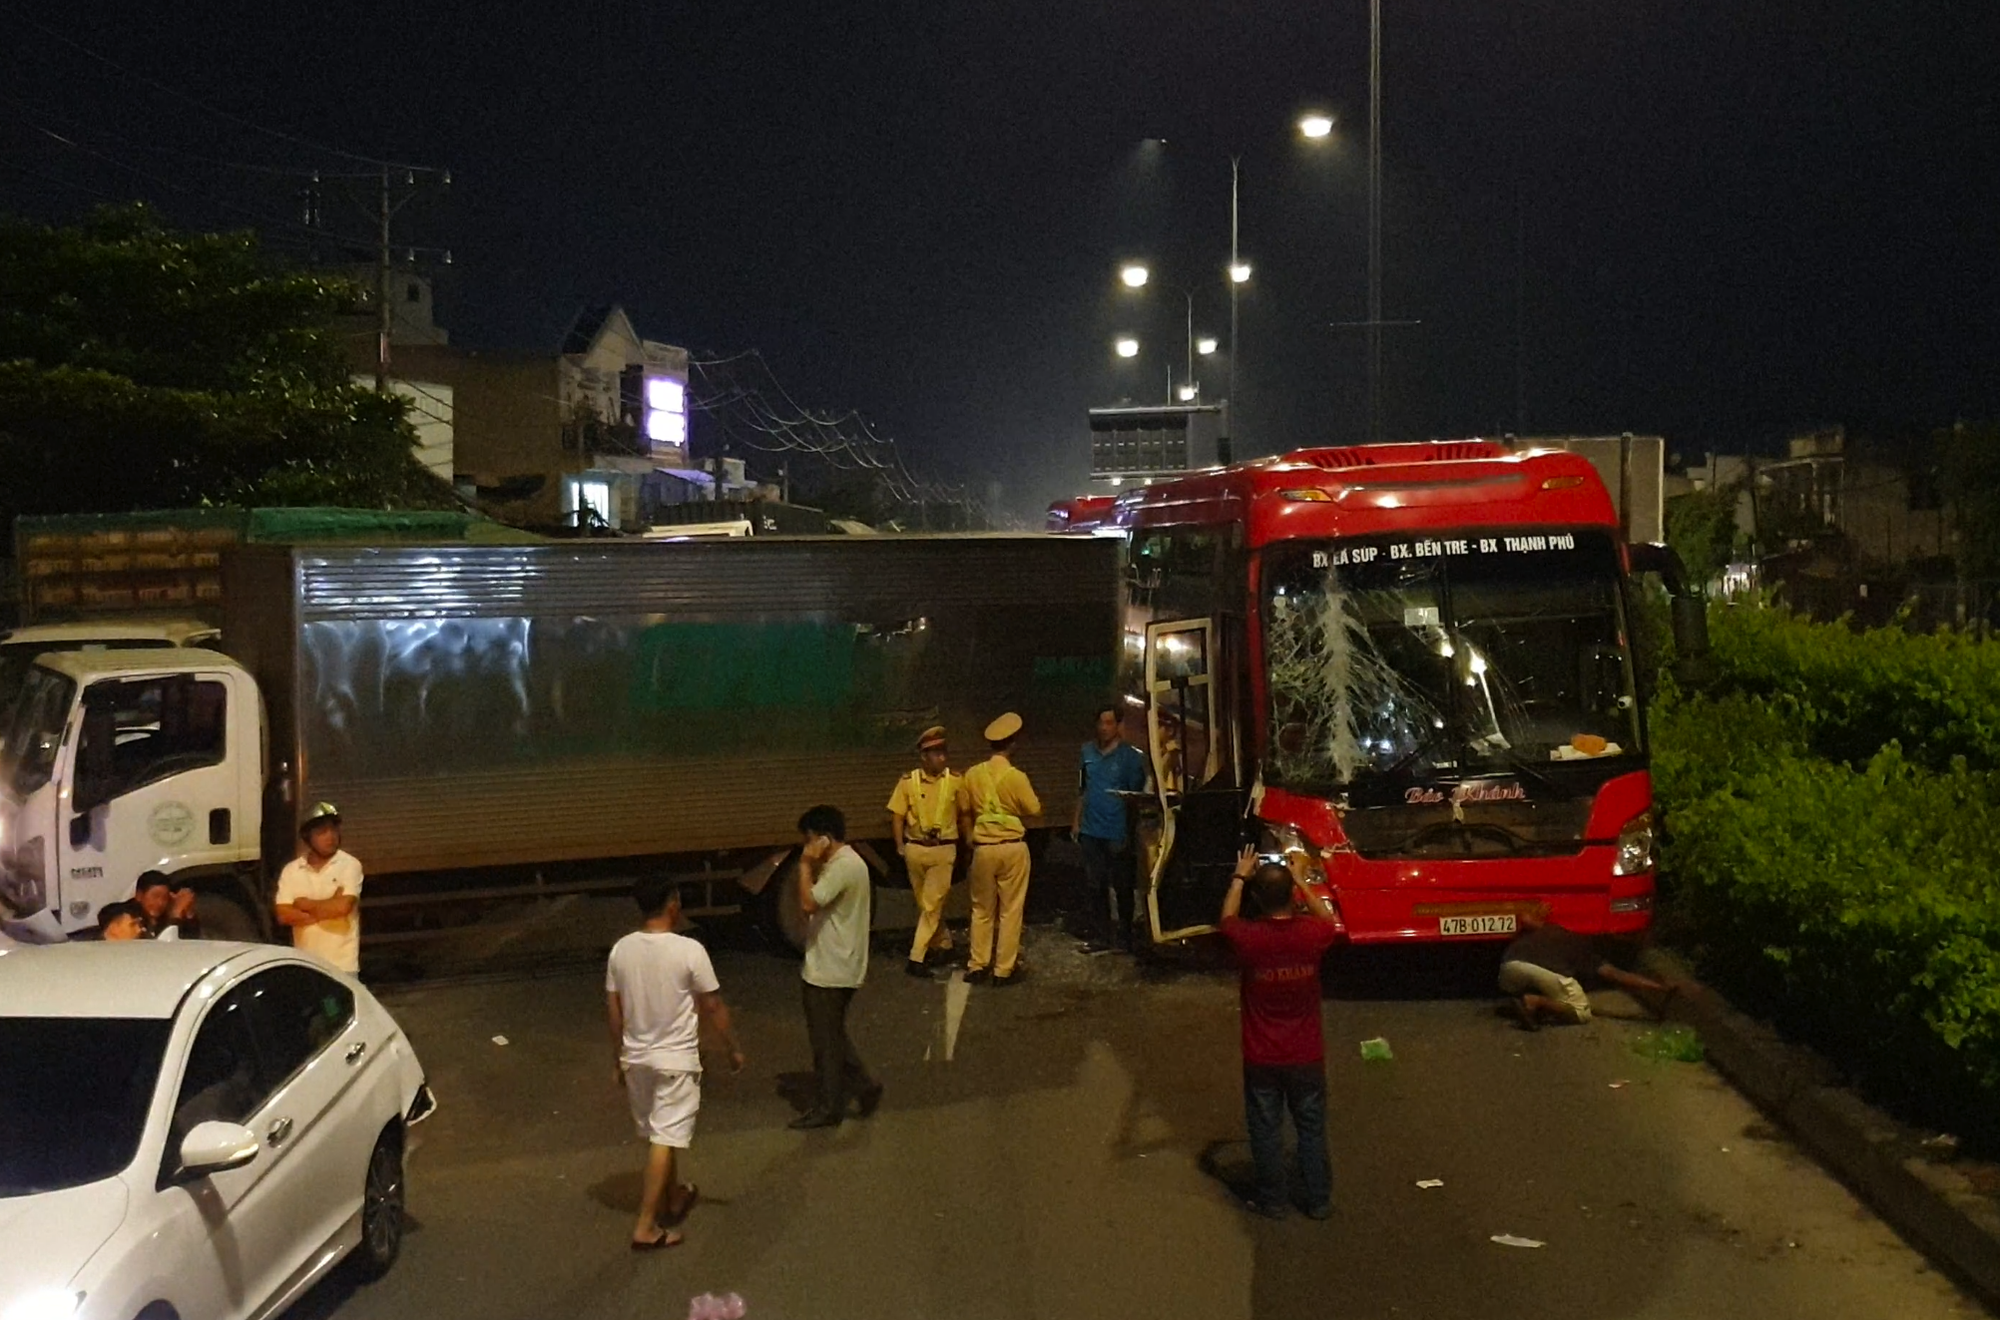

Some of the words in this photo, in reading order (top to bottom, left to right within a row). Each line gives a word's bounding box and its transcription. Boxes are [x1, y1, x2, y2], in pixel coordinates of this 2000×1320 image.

[1444, 540, 1469, 555] TRE
[1480, 539, 1498, 553] BX
[1504, 536, 1546, 554] THẠNH
